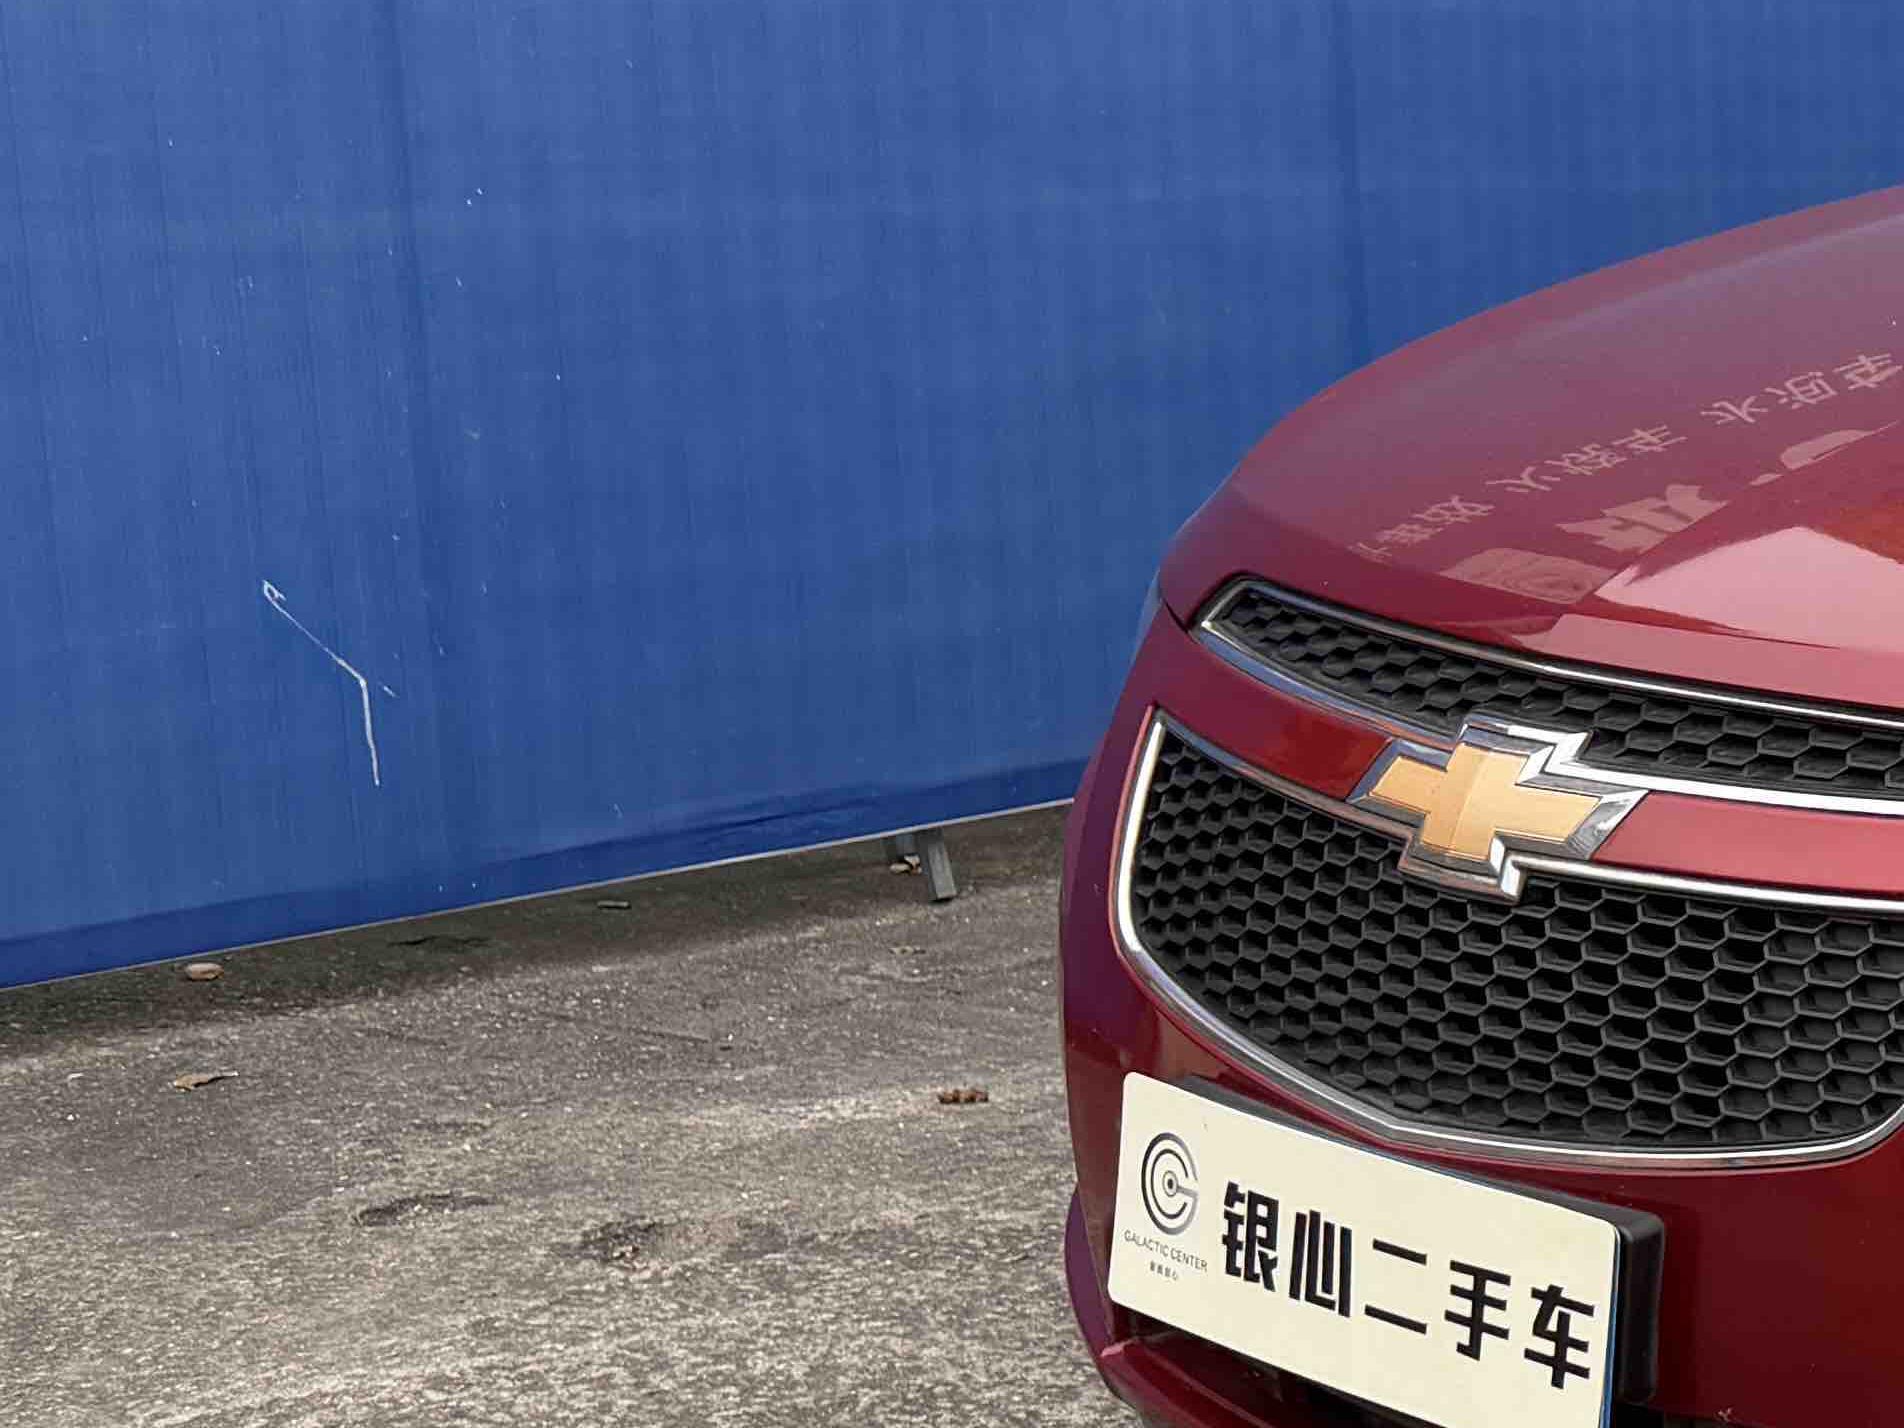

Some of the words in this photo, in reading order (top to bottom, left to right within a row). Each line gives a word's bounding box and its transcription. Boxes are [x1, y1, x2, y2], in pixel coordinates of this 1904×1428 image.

[1123, 1229, 1169, 1259] GALACTIC
[1170, 1247, 1208, 1272] CENTER
[1220, 1180, 1595, 1390] 银心二手车
